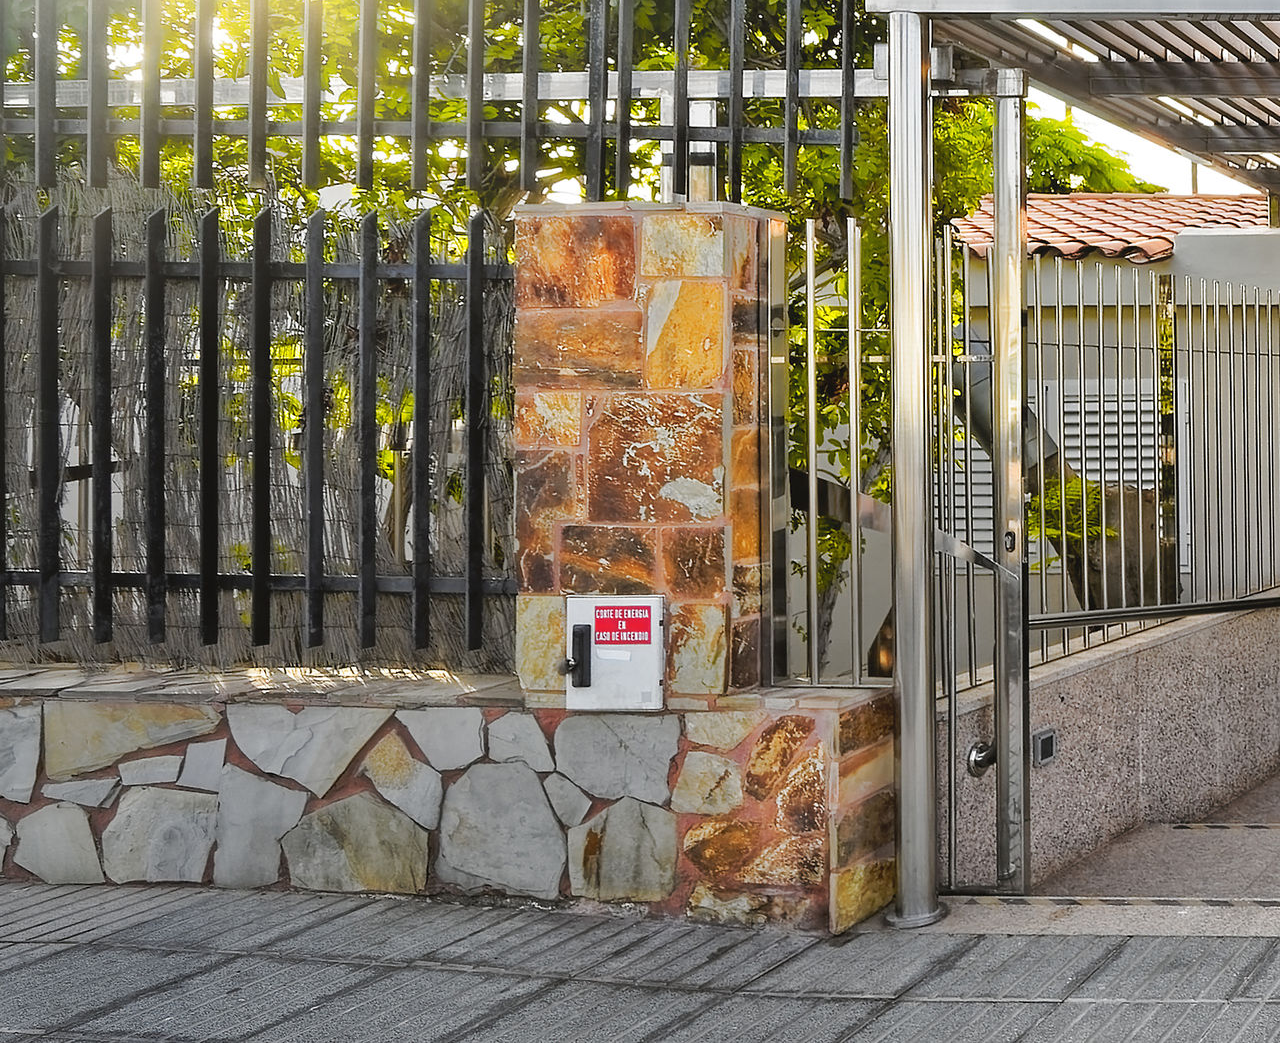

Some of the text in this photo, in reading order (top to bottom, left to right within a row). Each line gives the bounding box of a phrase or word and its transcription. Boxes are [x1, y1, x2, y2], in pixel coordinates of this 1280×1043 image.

[596, 609, 648, 618] CORTE DE ENERGIA
[618, 621, 626, 630] EN
[596, 632, 648, 641] CASO DE INCENDIO
